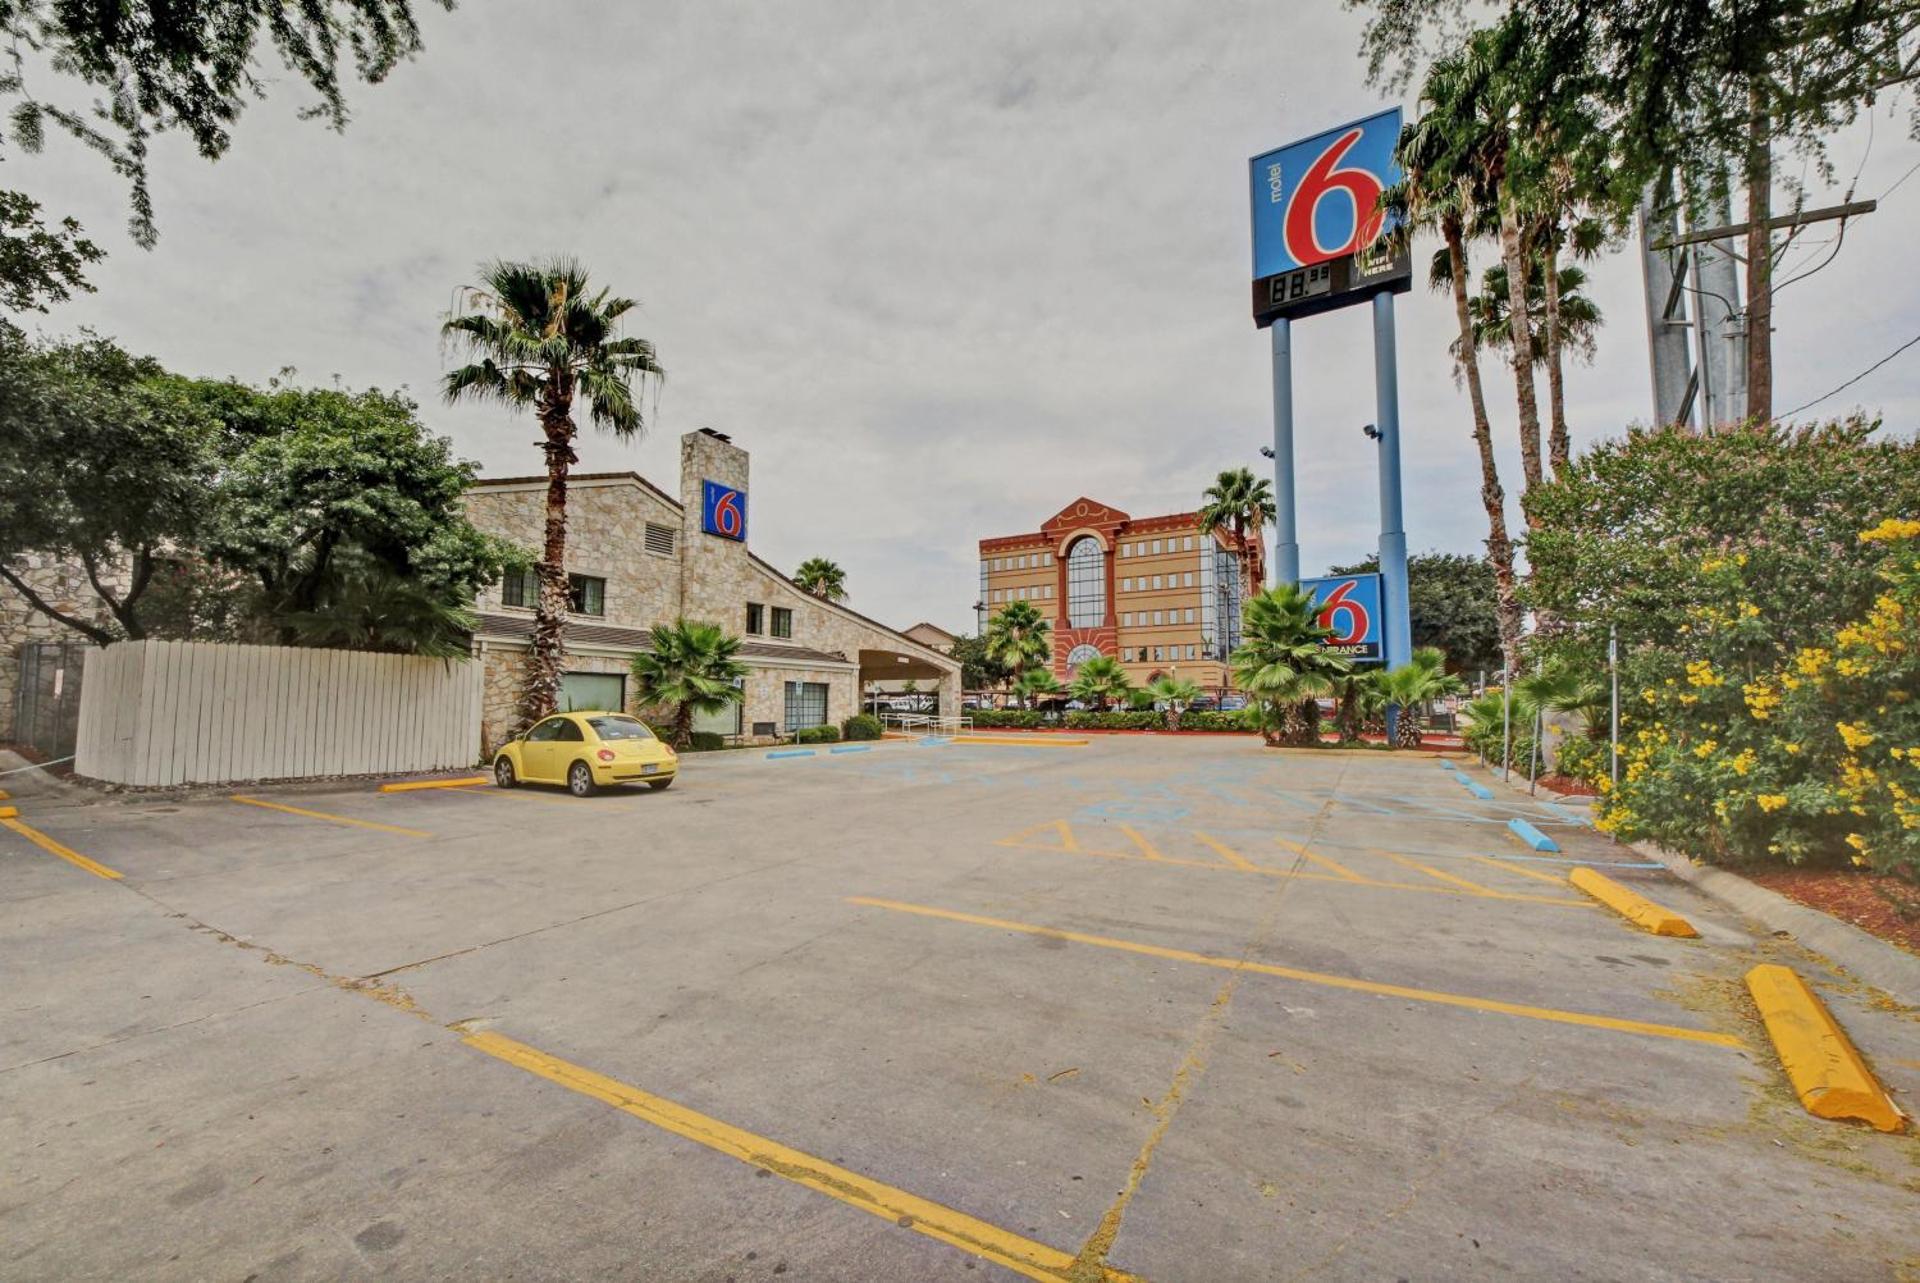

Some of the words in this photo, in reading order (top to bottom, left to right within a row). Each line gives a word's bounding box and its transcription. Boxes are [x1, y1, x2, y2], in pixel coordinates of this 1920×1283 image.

[1267, 163, 1281, 203] motel
[1283, 128, 1386, 266] 6
[714, 492, 741, 536] 6
[1316, 580, 1369, 644] 6
